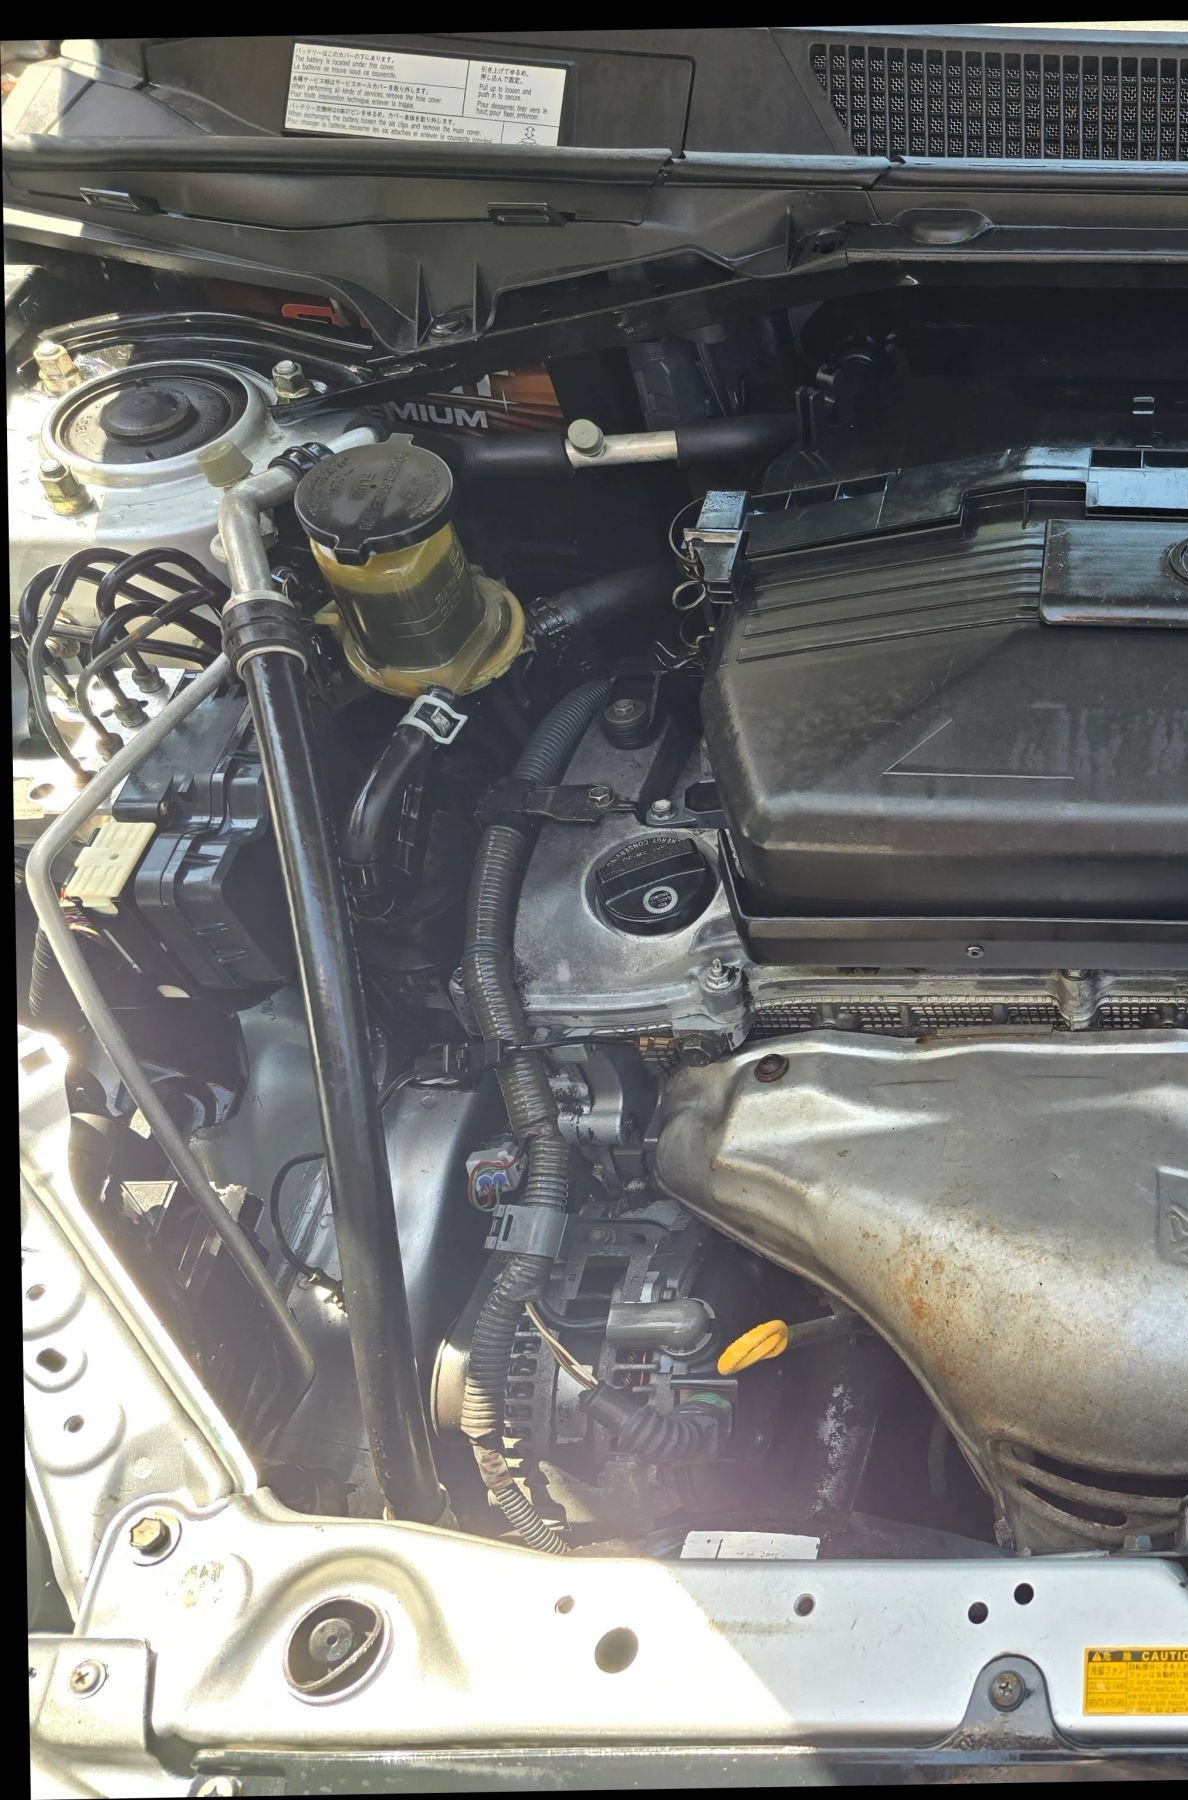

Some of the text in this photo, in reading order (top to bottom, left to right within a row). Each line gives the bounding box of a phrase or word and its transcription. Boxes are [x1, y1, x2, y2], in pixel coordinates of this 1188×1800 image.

[306, 55, 323, 64] battery
[331, 58, 350, 66] located
[302, 63, 321, 71] batterie
[307, 85, 332, 94] performing
[477, 100, 489, 108] Pour
[397, 121, 408, 129] clips
[606, 839, 649, 868] CONSERVING
